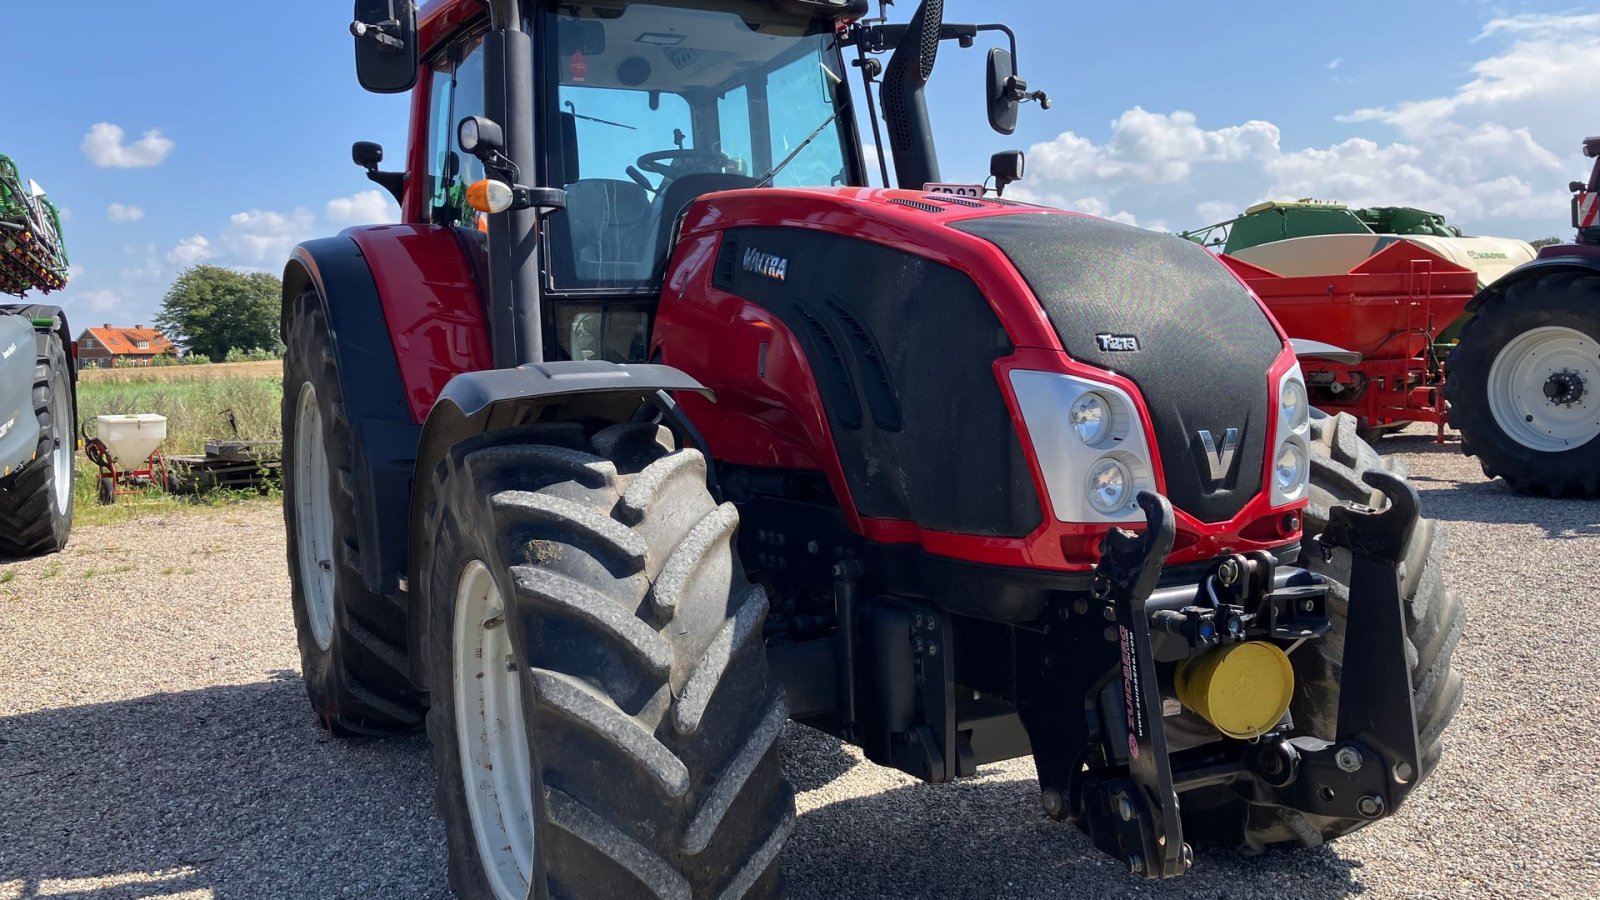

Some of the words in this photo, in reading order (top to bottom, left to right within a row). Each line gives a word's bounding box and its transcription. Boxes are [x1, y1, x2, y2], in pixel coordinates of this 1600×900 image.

[743, 247, 788, 280] VALTRA
[1096, 334, 1139, 352] T213
[1198, 428, 1238, 480] V
[1120, 624, 1135, 731] ZUIDBERG
